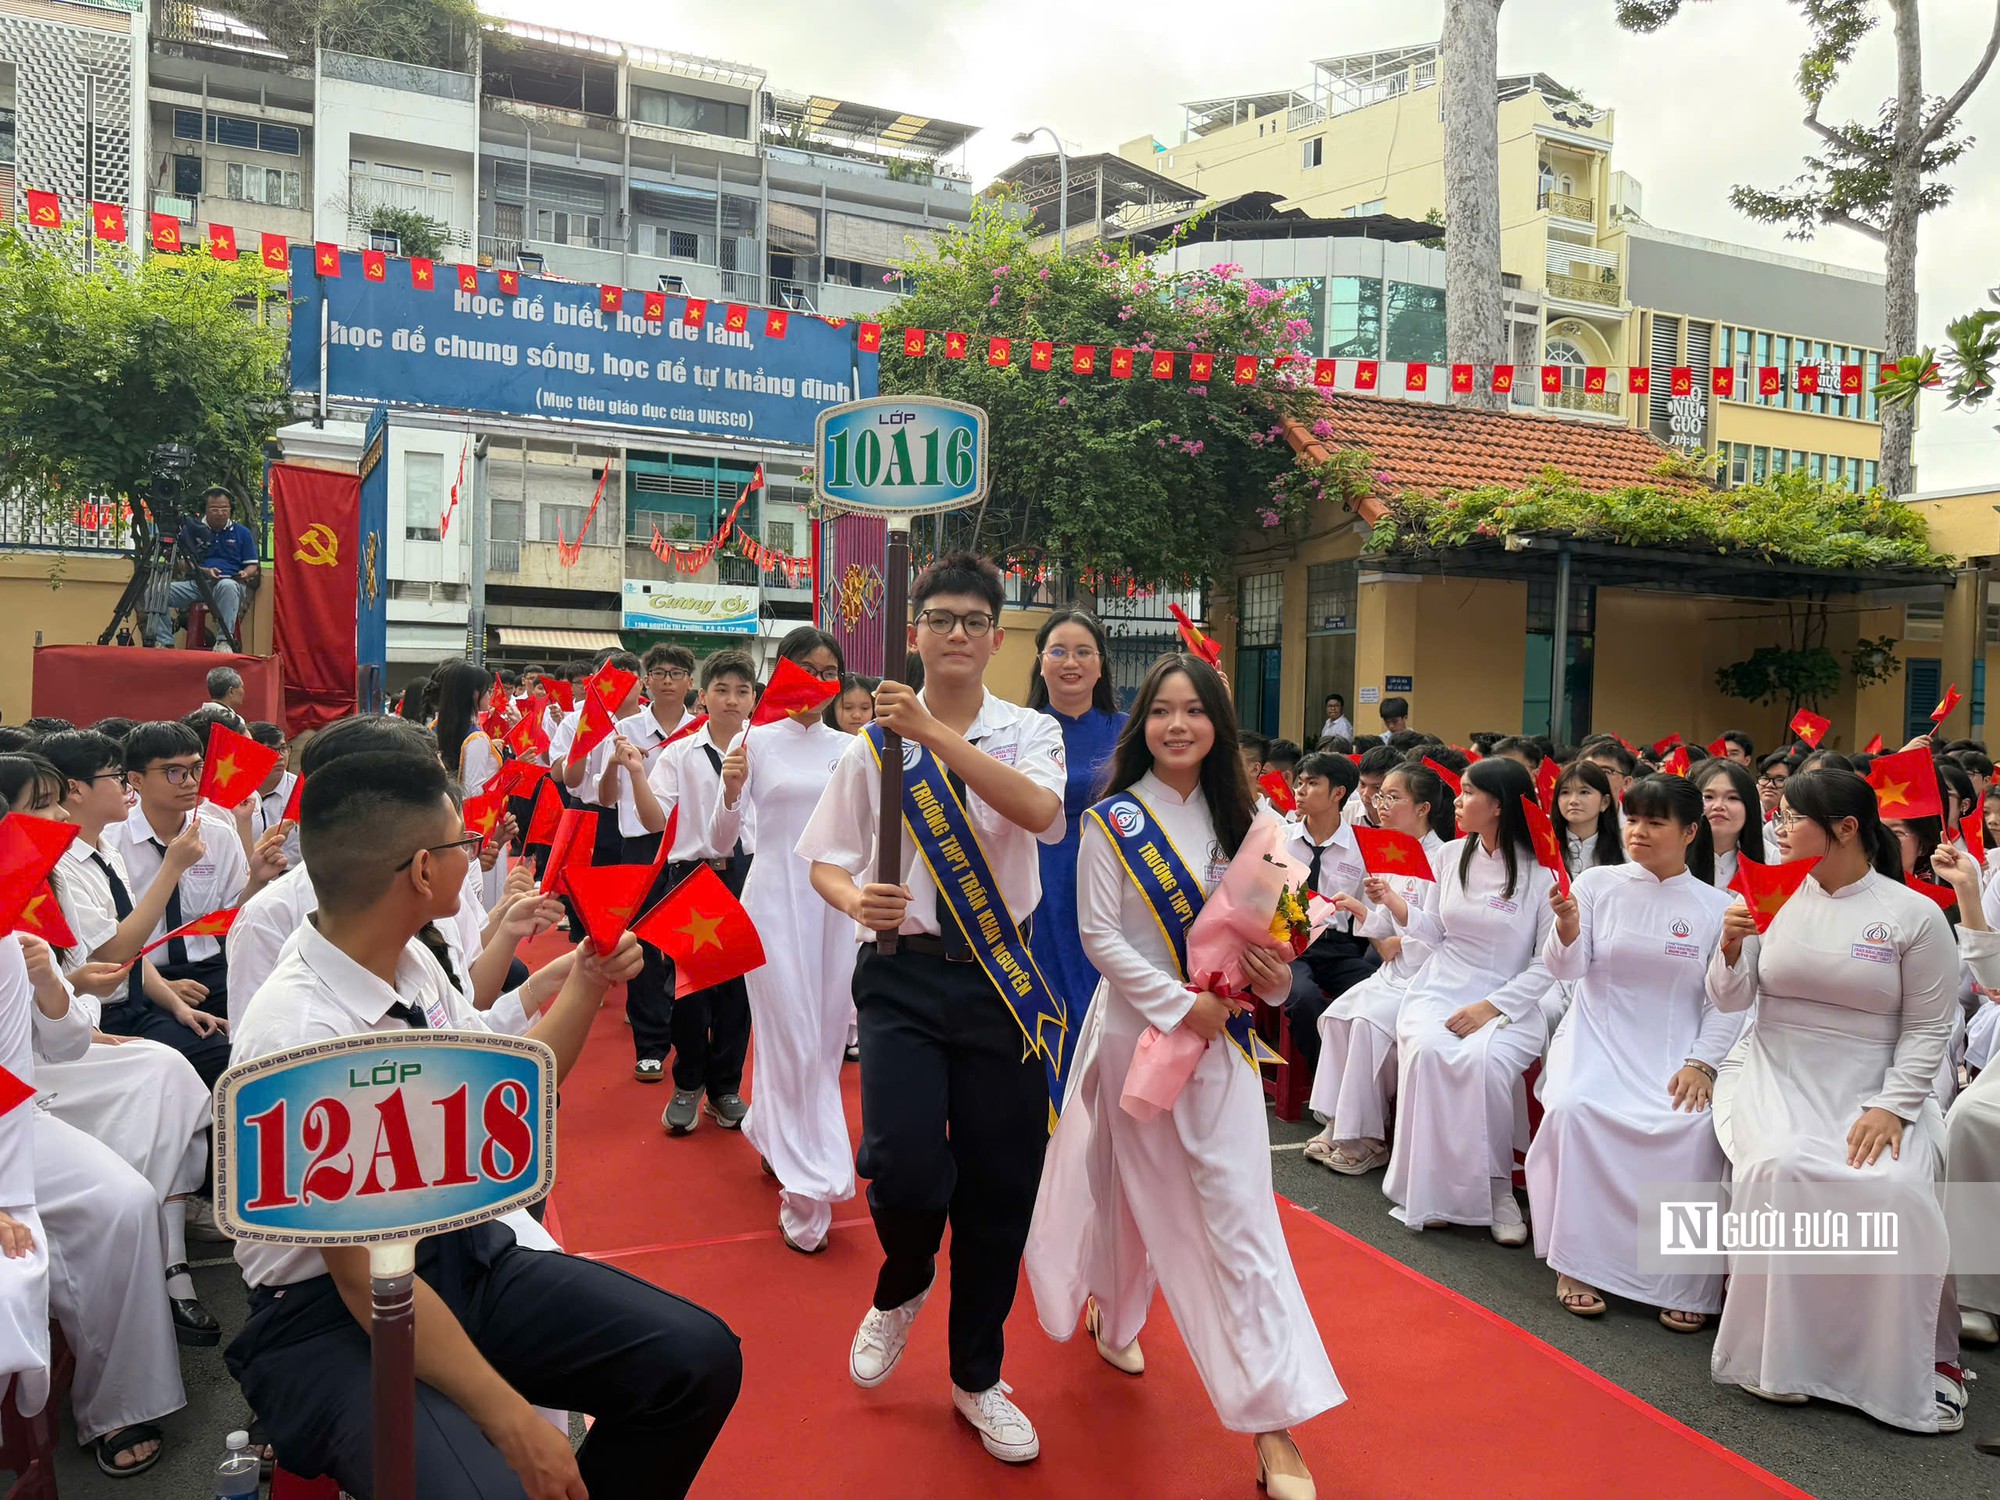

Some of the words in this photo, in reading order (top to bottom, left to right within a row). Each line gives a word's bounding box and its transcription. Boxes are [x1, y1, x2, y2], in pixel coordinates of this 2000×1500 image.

[454, 289, 504, 320] Học
[512, 294, 545, 322] để
[553, 301, 608, 332] biết,
[616, 310, 662, 339] học
[330, 320, 383, 351] học
[391, 325, 426, 353] để
[434, 335, 518, 366] chung
[526, 342, 595, 375] sống,
[603, 353, 649, 382] học
[657, 356, 687, 383] để
[693, 365, 720, 391] tự
[725, 367, 795, 398] khẳng
[801, 378, 850, 405] định
[535, 387, 573, 411] (Mục
[577, 396, 604, 413] tiêu
[608, 400, 639, 418] giáo
[641, 403, 667, 421] dục
[670, 405, 695, 422] của
[698, 409, 754, 431] UNESCO)
[878, 409, 916, 425] LỚP
[1670, 415, 1702, 434] GUO
[1672, 399, 1701, 418] NIU
[828, 426, 975, 488] 10A16
[909, 779, 951, 838] TRƯỜNG
[938, 833, 971, 872] THPT
[976, 908, 1002, 945] KHAI
[990, 941, 1033, 997] NGUYÊN
[1138, 841, 1178, 892] TRƯỜNG
[1168, 888, 1194, 923] THPT
[349, 1059, 422, 1087] LỚP
[244, 1079, 533, 1211] 12A18
